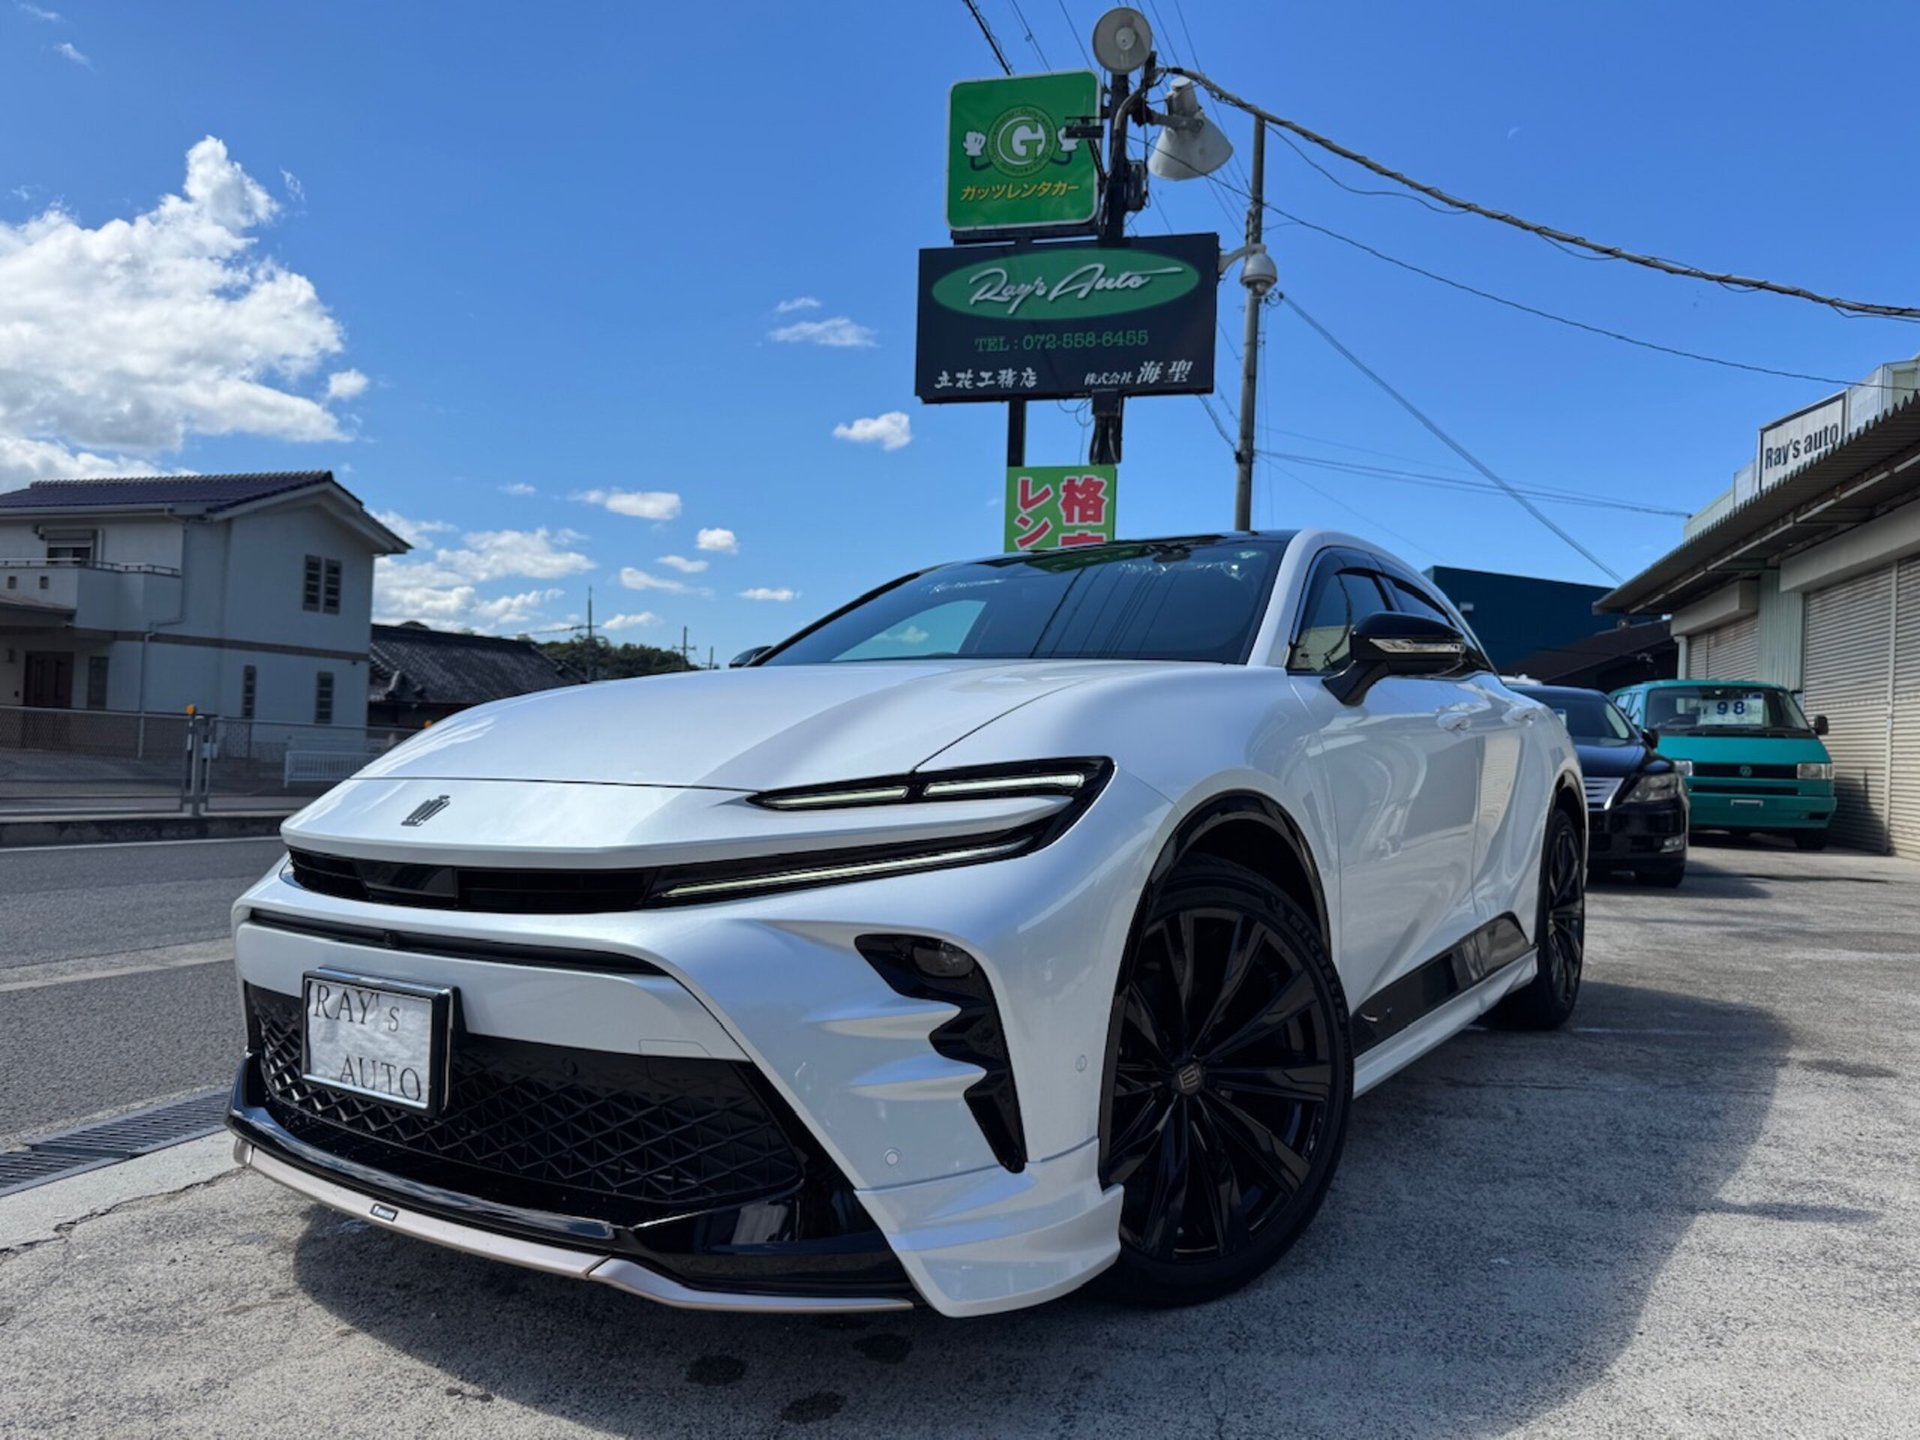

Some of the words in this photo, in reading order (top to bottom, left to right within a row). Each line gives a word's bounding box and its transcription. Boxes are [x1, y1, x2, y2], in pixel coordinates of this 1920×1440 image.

[961, 181, 1079, 201] ガッツレンタカー
[968, 267, 1047, 315] Ray's
[1048, 262, 1183, 301] Auto
[975, 335, 1010, 352] TEL
[934, 366, 1038, 389] 立花工務店
[1084, 371, 1133, 386] 株式会社
[1765, 438, 1801, 470] Ray's
[1804, 423, 1839, 455] auto
[1014, 477, 1053, 550] レン
[339, 1055, 421, 1102] AUTO
